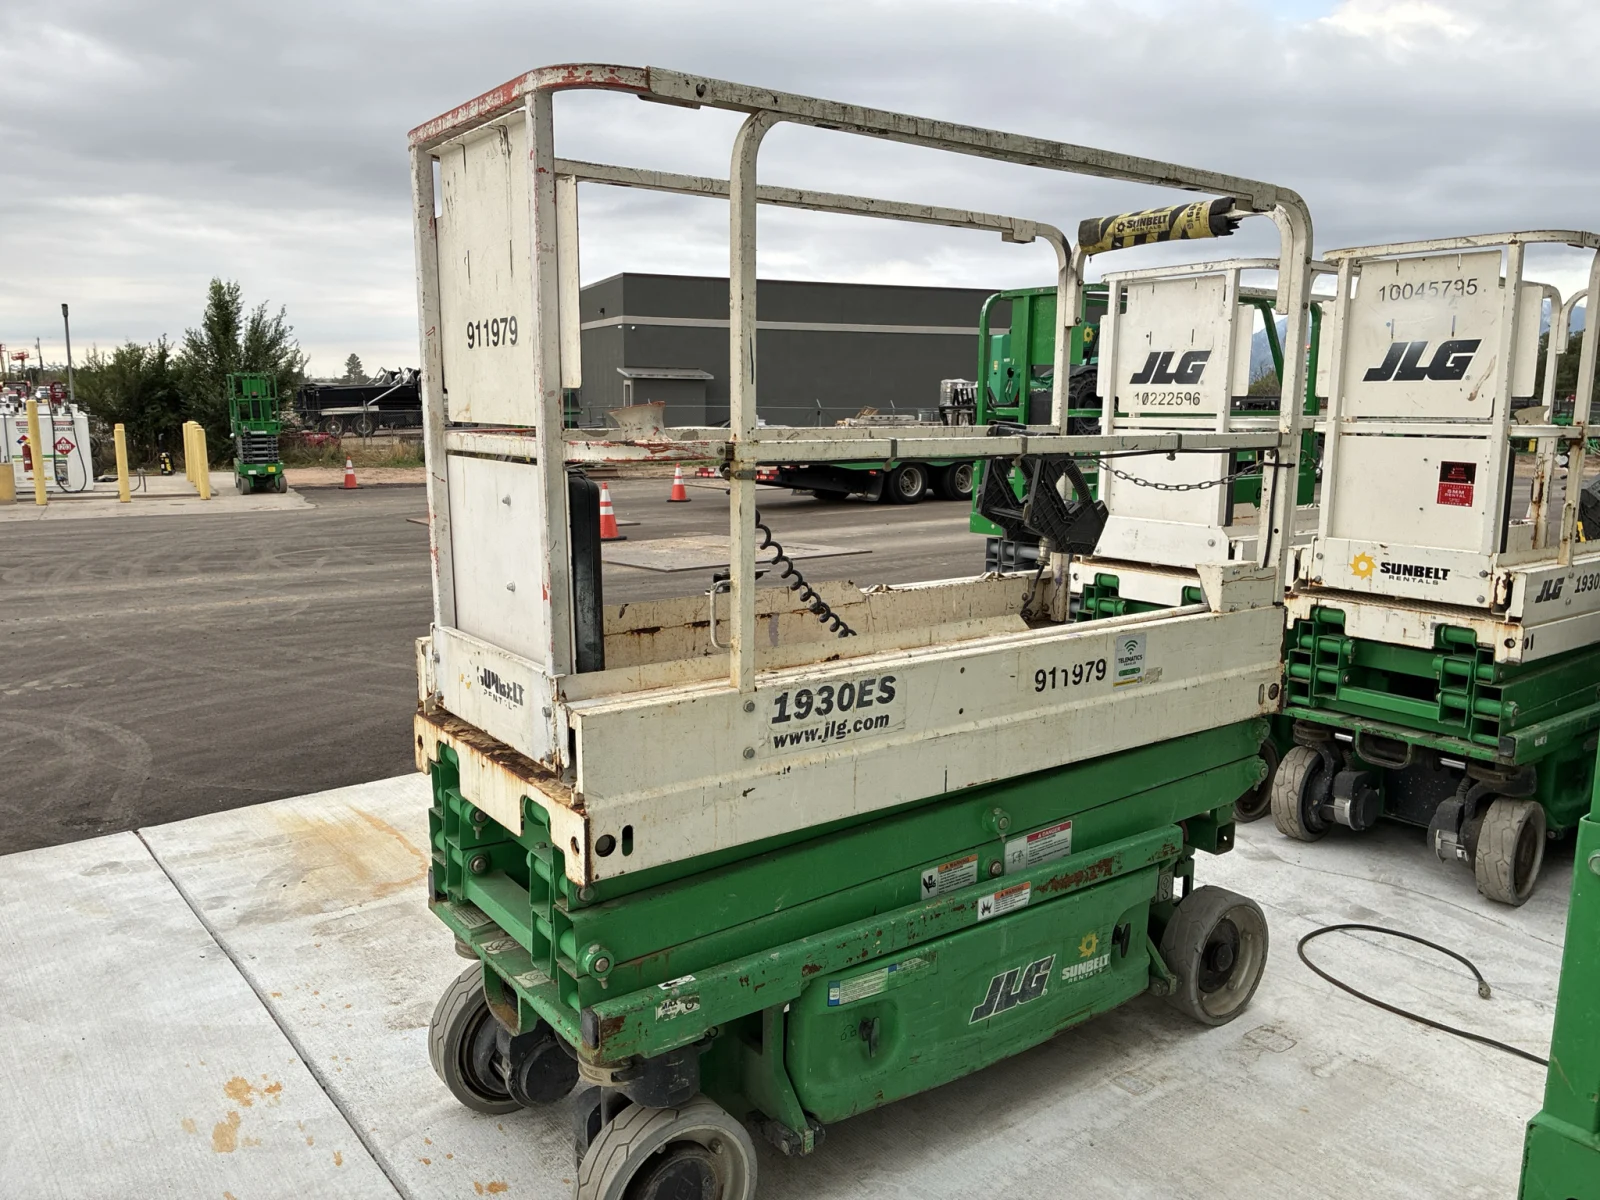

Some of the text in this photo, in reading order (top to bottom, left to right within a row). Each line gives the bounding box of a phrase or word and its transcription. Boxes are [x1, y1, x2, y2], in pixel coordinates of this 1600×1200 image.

[1126, 214, 1169, 229] SUNBELT
[466, 315, 518, 349] 911979
[1129, 349, 1212, 385] JLG
[1362, 338, 1483, 382] JLG
[1134, 391, 1201, 406] 10222596
[1380, 561, 1451, 581] SUNBELT
[1388, 574, 1439, 585] RENTALS
[1534, 572, 1600, 604] JLG 1930
[1034, 658, 1107, 692] 911979
[1117, 654, 1143, 665] TELEMATICS
[771, 675, 897, 724] 1930ES
[773, 714, 890, 749] www.jlg.com
[1061, 953, 1110, 981] SUNBELT
[968, 953, 1057, 1025] JLG
